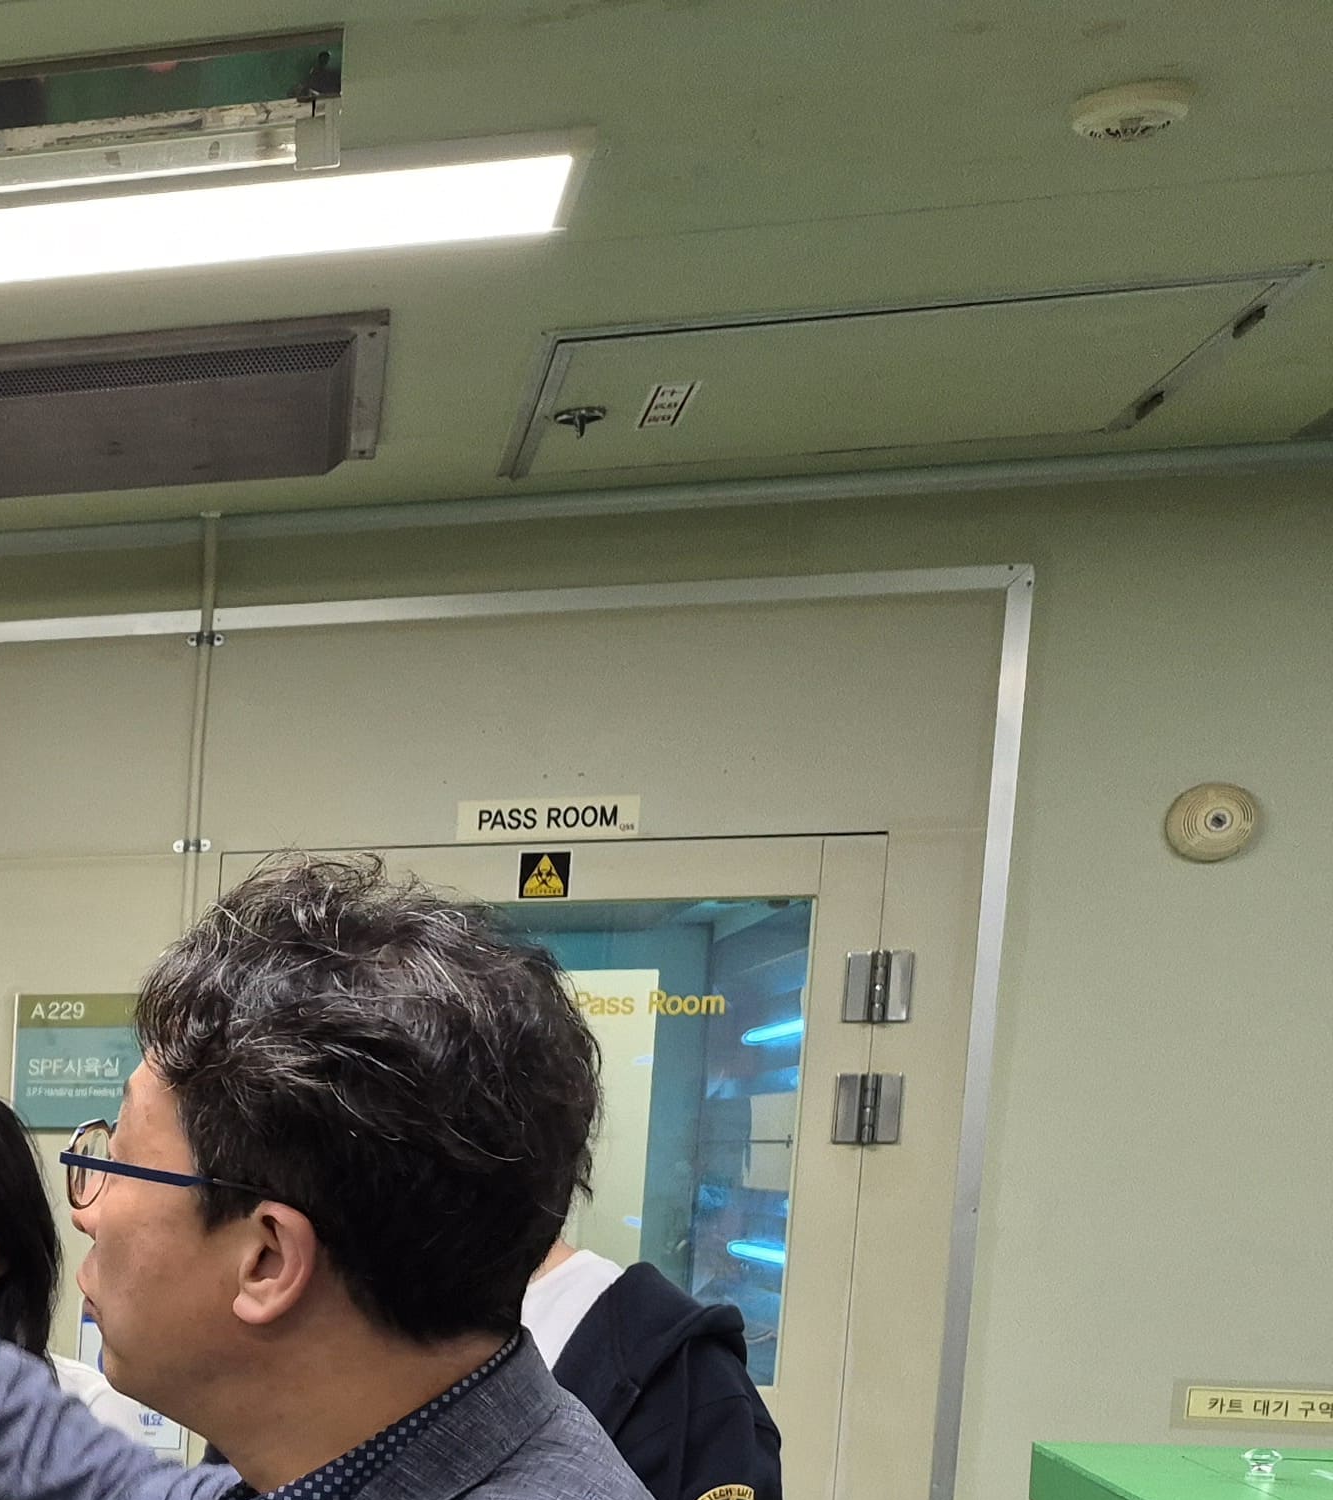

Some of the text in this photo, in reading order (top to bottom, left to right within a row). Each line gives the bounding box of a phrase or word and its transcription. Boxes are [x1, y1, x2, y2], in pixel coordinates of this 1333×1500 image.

[478, 804, 619, 831] PASS ROOM
[30, 1001, 85, 1020] A229
[577, 989, 725, 1016] Pass Room
[28, 1056, 120, 1078] SPF사육실
[1207, 1395, 1333, 1419] 카트 대기 구역
